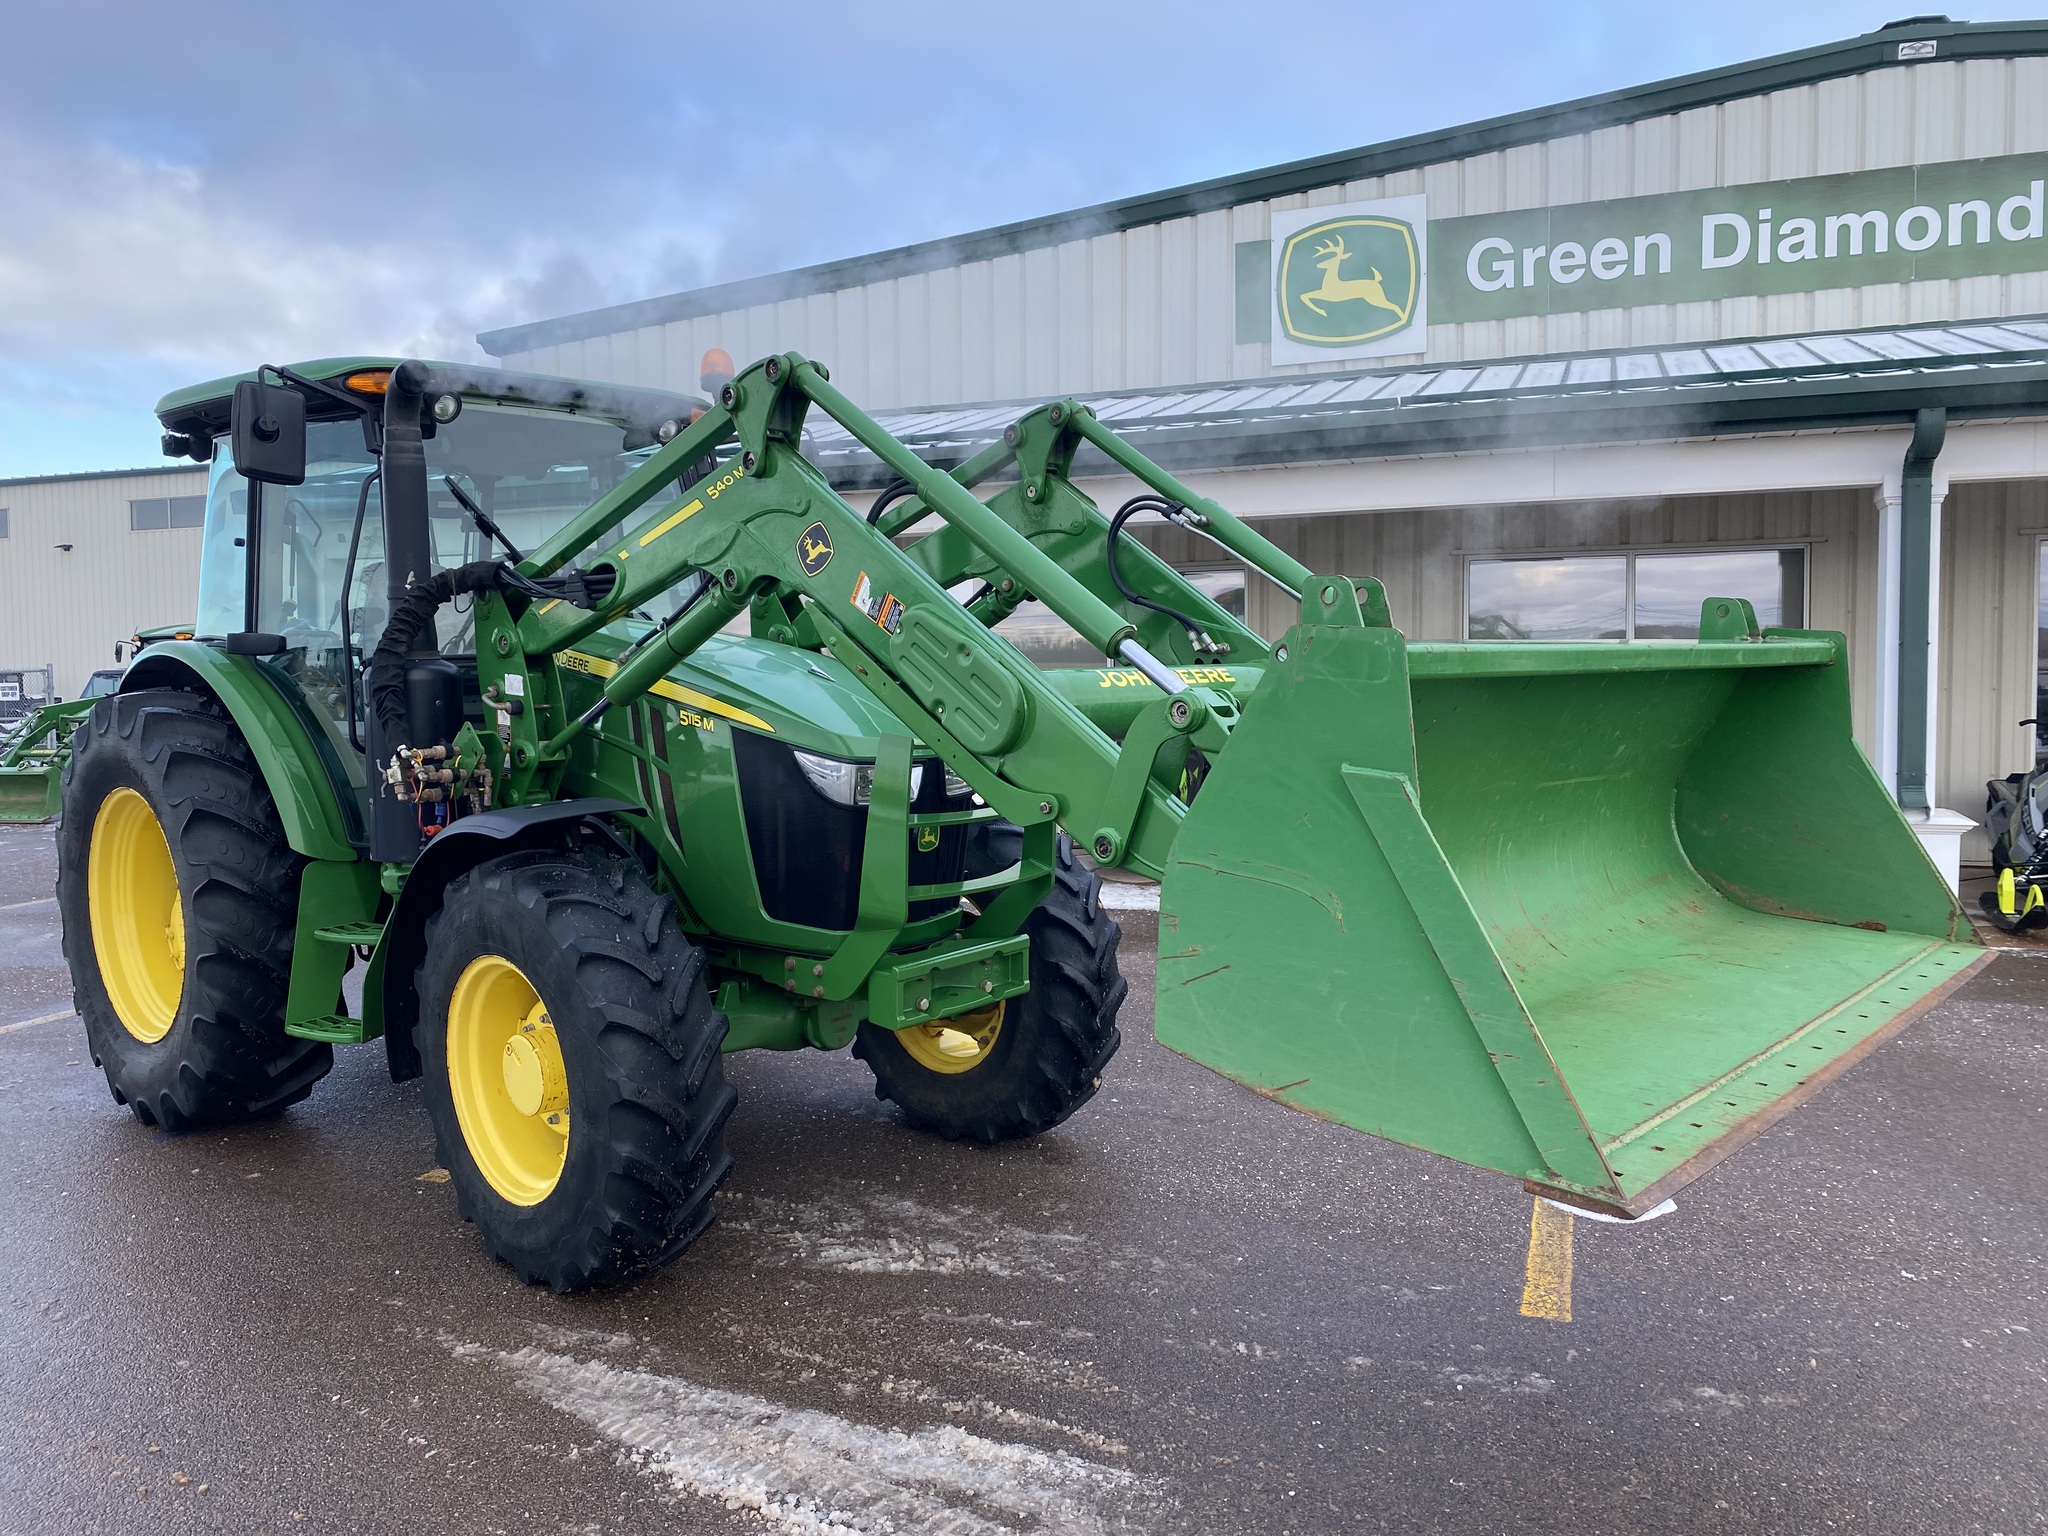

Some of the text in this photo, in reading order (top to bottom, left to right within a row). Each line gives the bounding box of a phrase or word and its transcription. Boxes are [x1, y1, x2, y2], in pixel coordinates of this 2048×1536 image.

[1466, 179, 2045, 292] Green Diamond
[705, 465, 744, 500] 540 M
[561, 652, 590, 672] DEERE
[1172, 668, 1236, 684] EERE
[680, 709, 715, 733] 5115 M
